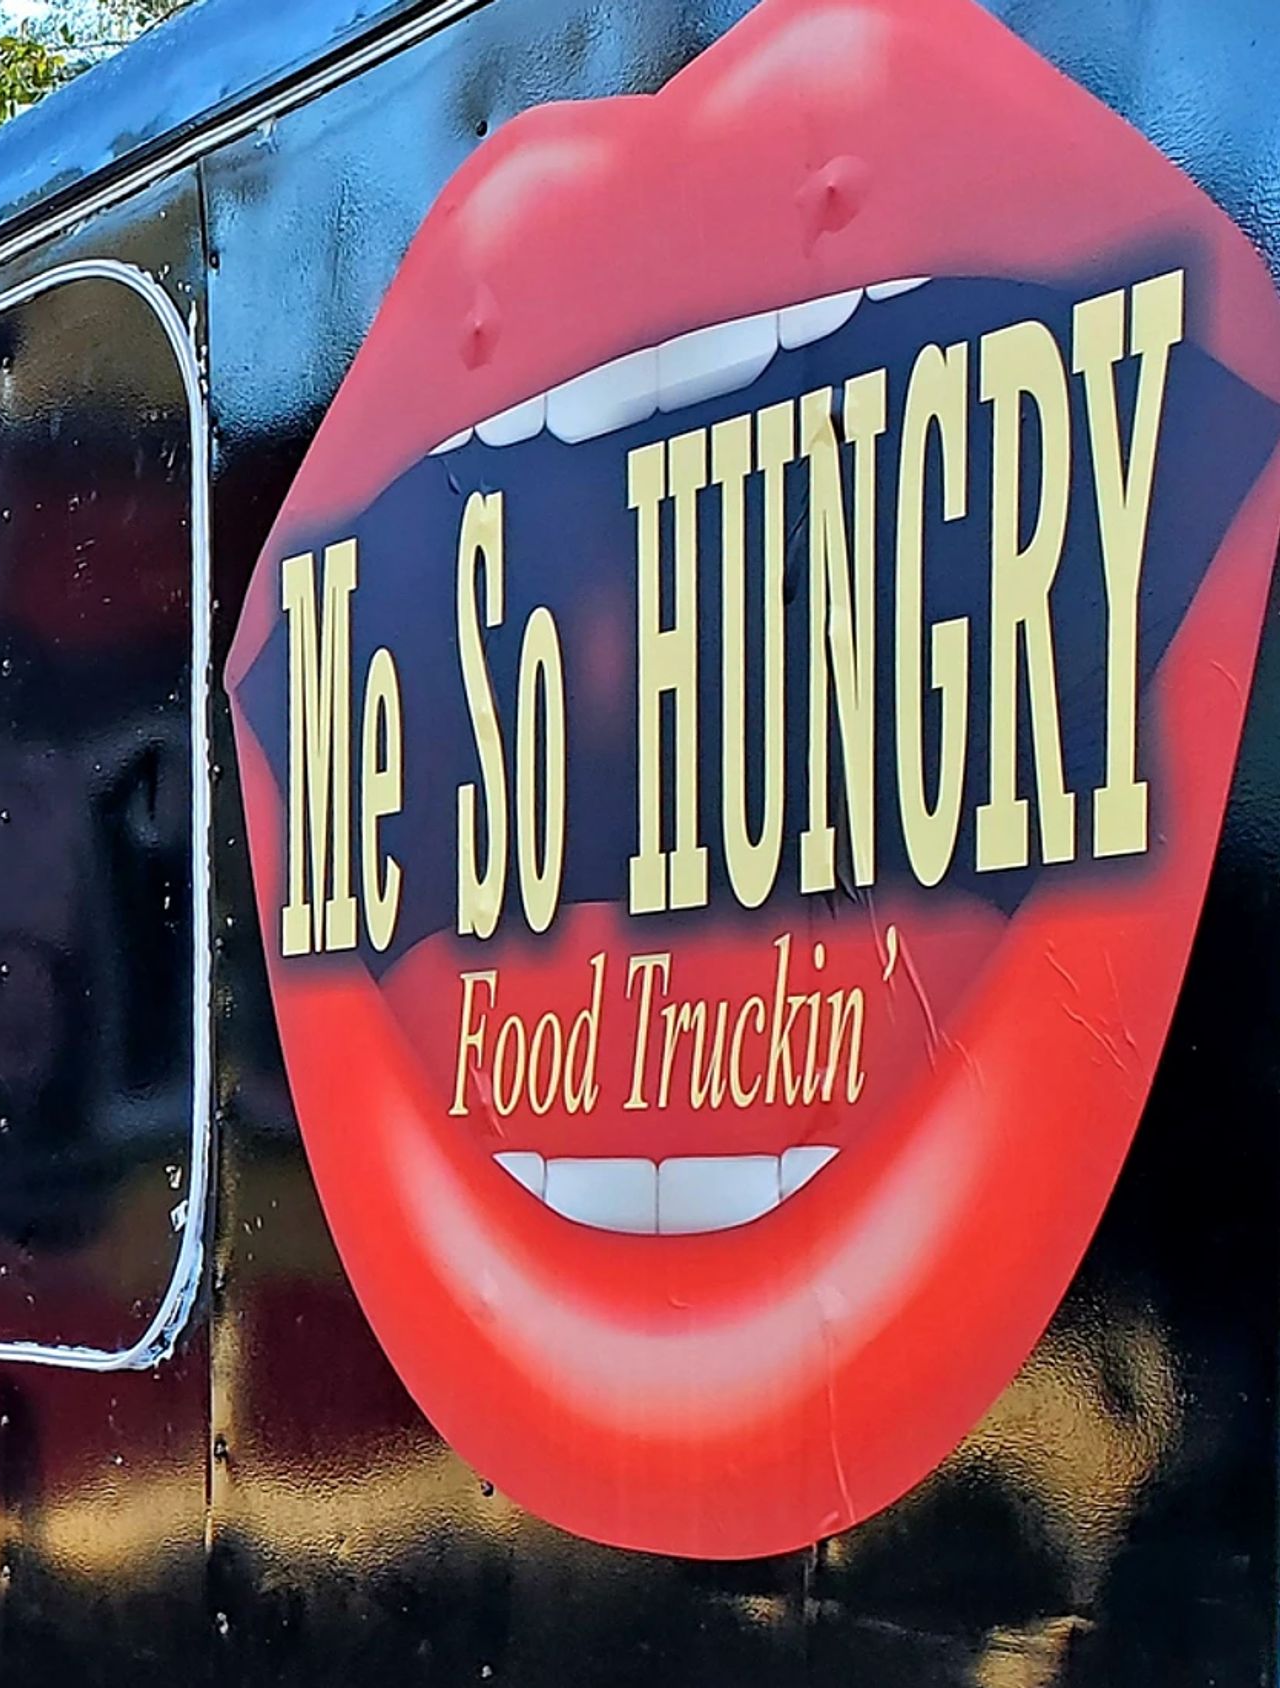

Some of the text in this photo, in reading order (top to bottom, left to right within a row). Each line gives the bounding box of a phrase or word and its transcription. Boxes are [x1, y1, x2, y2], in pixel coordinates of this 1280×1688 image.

[281, 269, 1186, 957] Me So HUNGRY
[447, 924, 899, 1118] Food Truckin'
